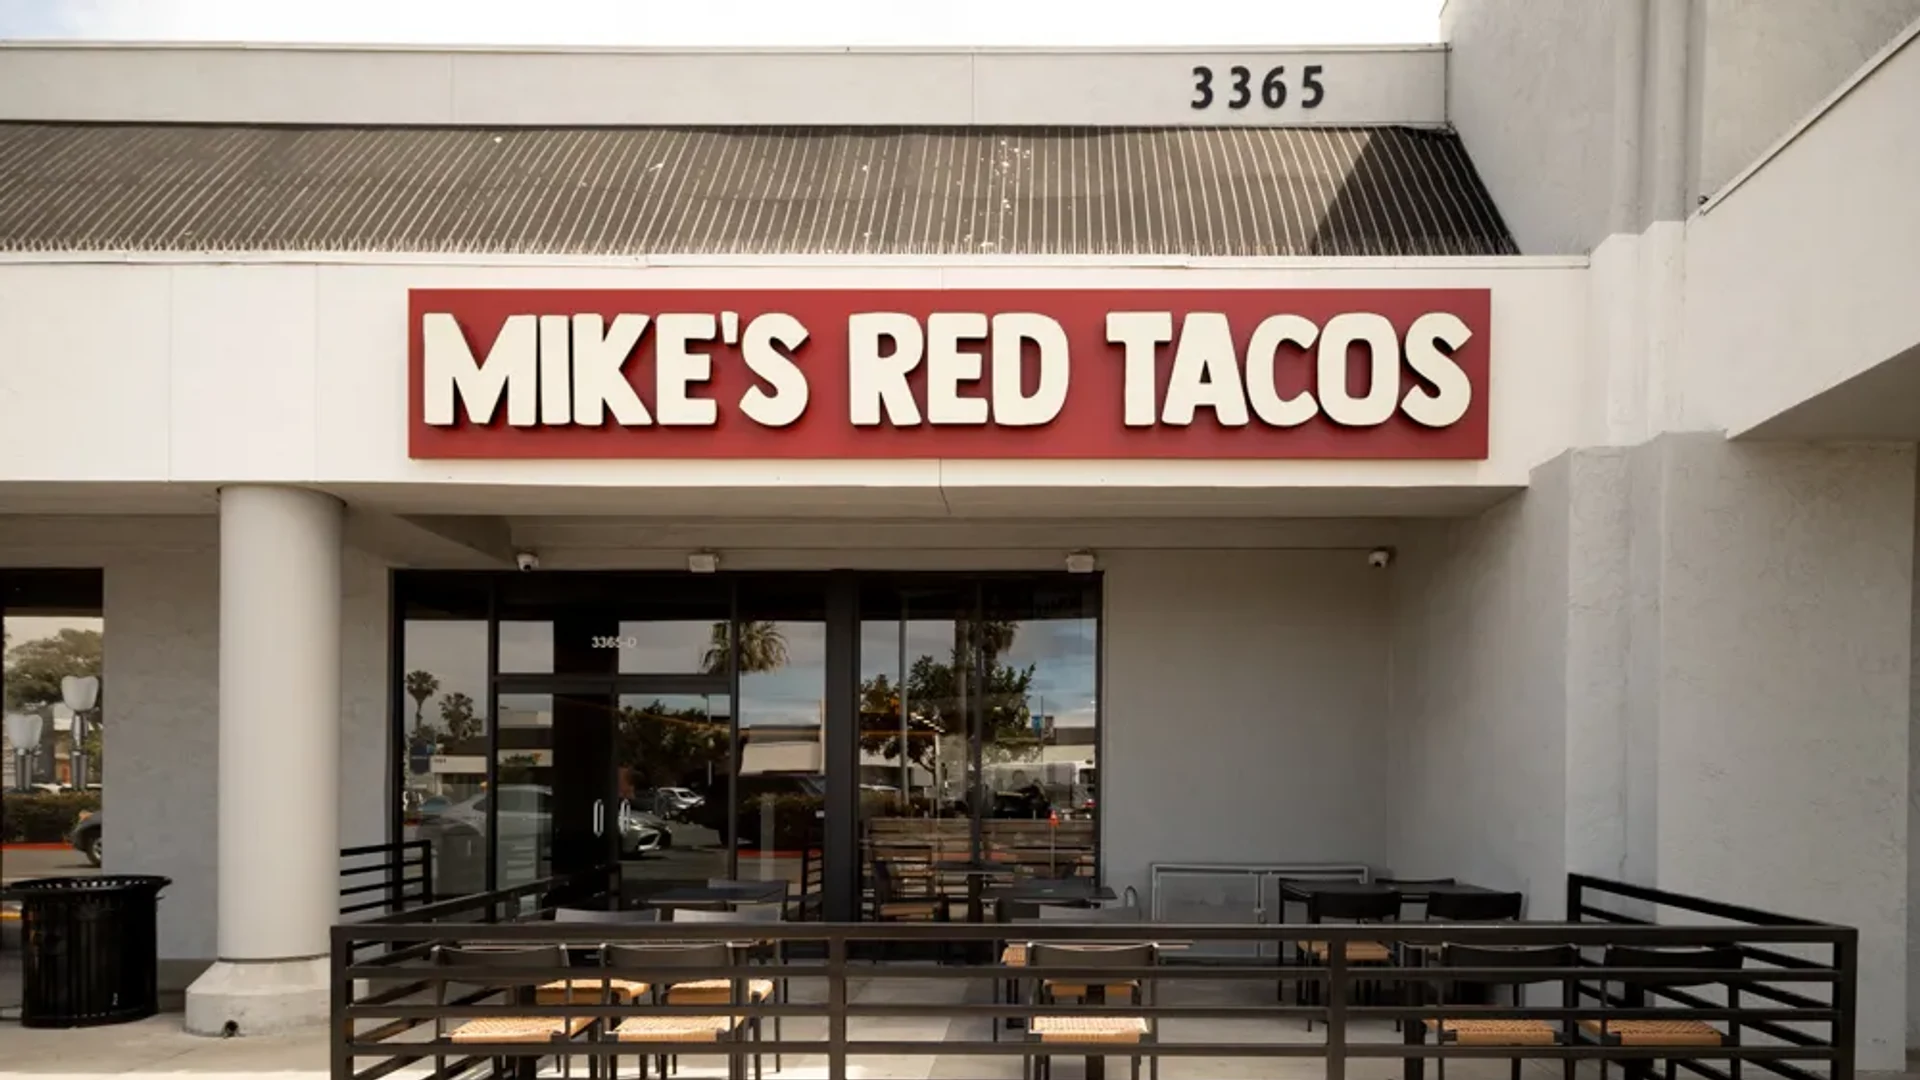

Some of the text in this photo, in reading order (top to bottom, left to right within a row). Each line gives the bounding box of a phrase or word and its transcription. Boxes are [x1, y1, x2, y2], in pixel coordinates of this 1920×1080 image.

[1190, 65, 1324, 109] 3365
[422, 311, 1473, 428] MIKE'S RED TACOS
[591, 635, 637, 649] 3365-D
